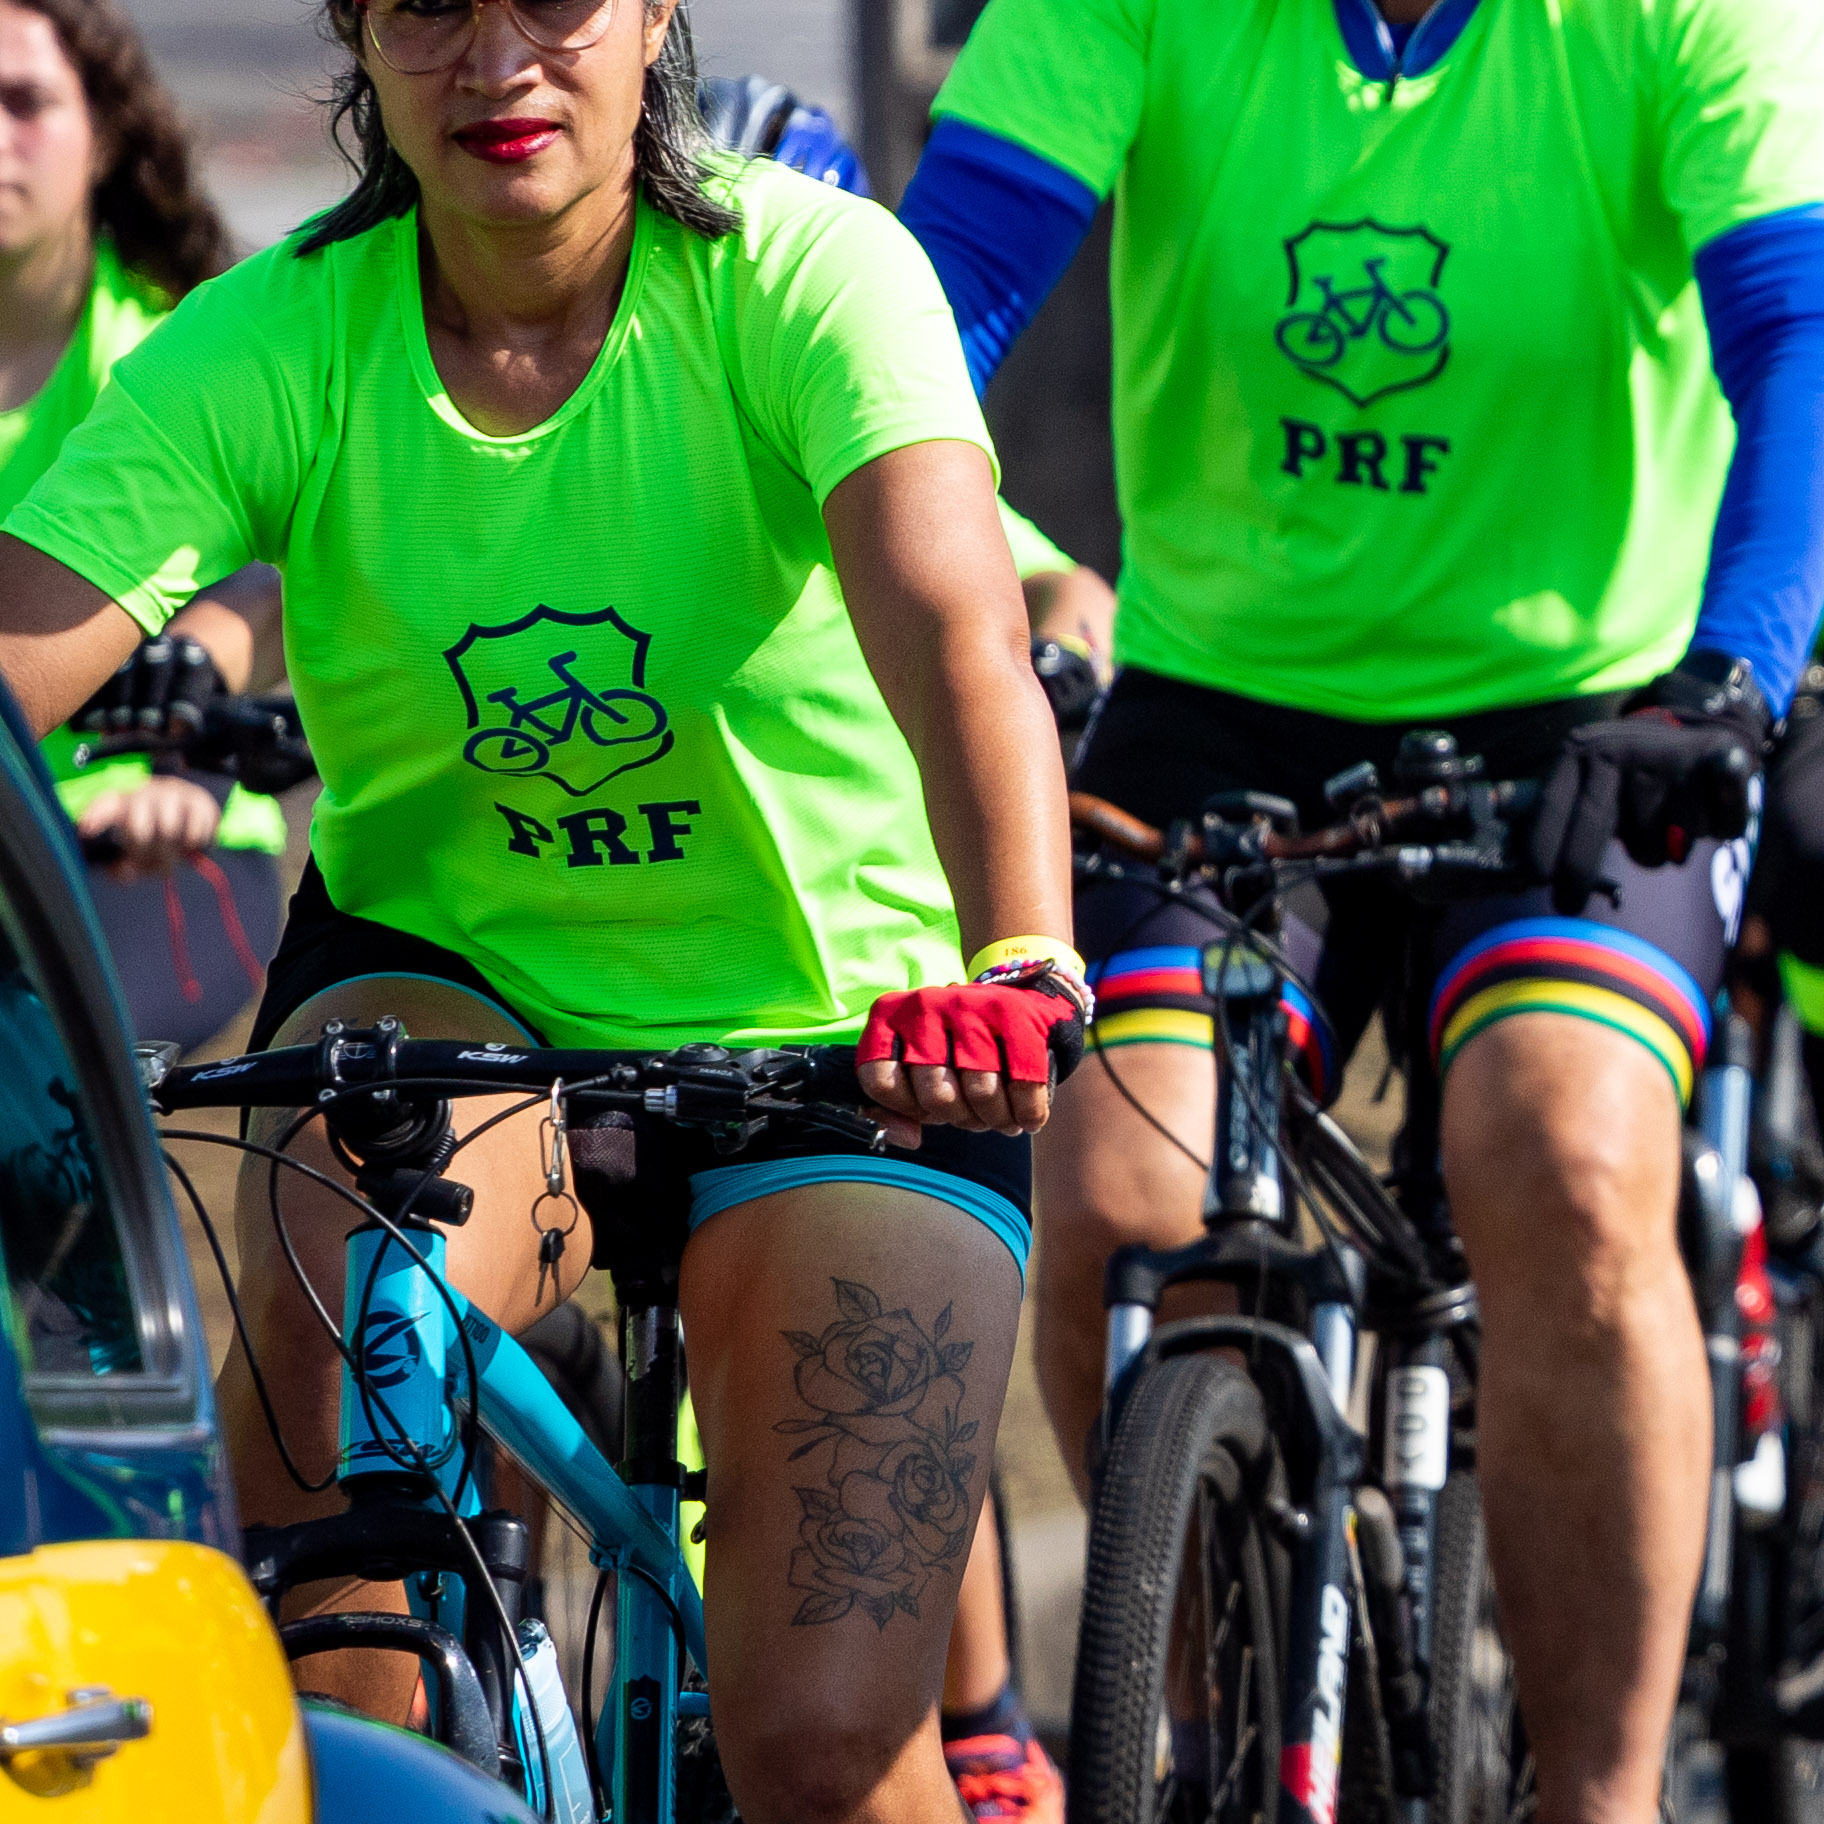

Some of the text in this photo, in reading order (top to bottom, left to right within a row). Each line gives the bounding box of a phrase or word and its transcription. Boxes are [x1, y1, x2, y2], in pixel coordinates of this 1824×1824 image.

[1278, 415, 1451, 495] PRF
[494, 800, 702, 868] PRF
[190, 1061, 259, 1082] KSW
[457, 1050, 529, 1064] KSW
